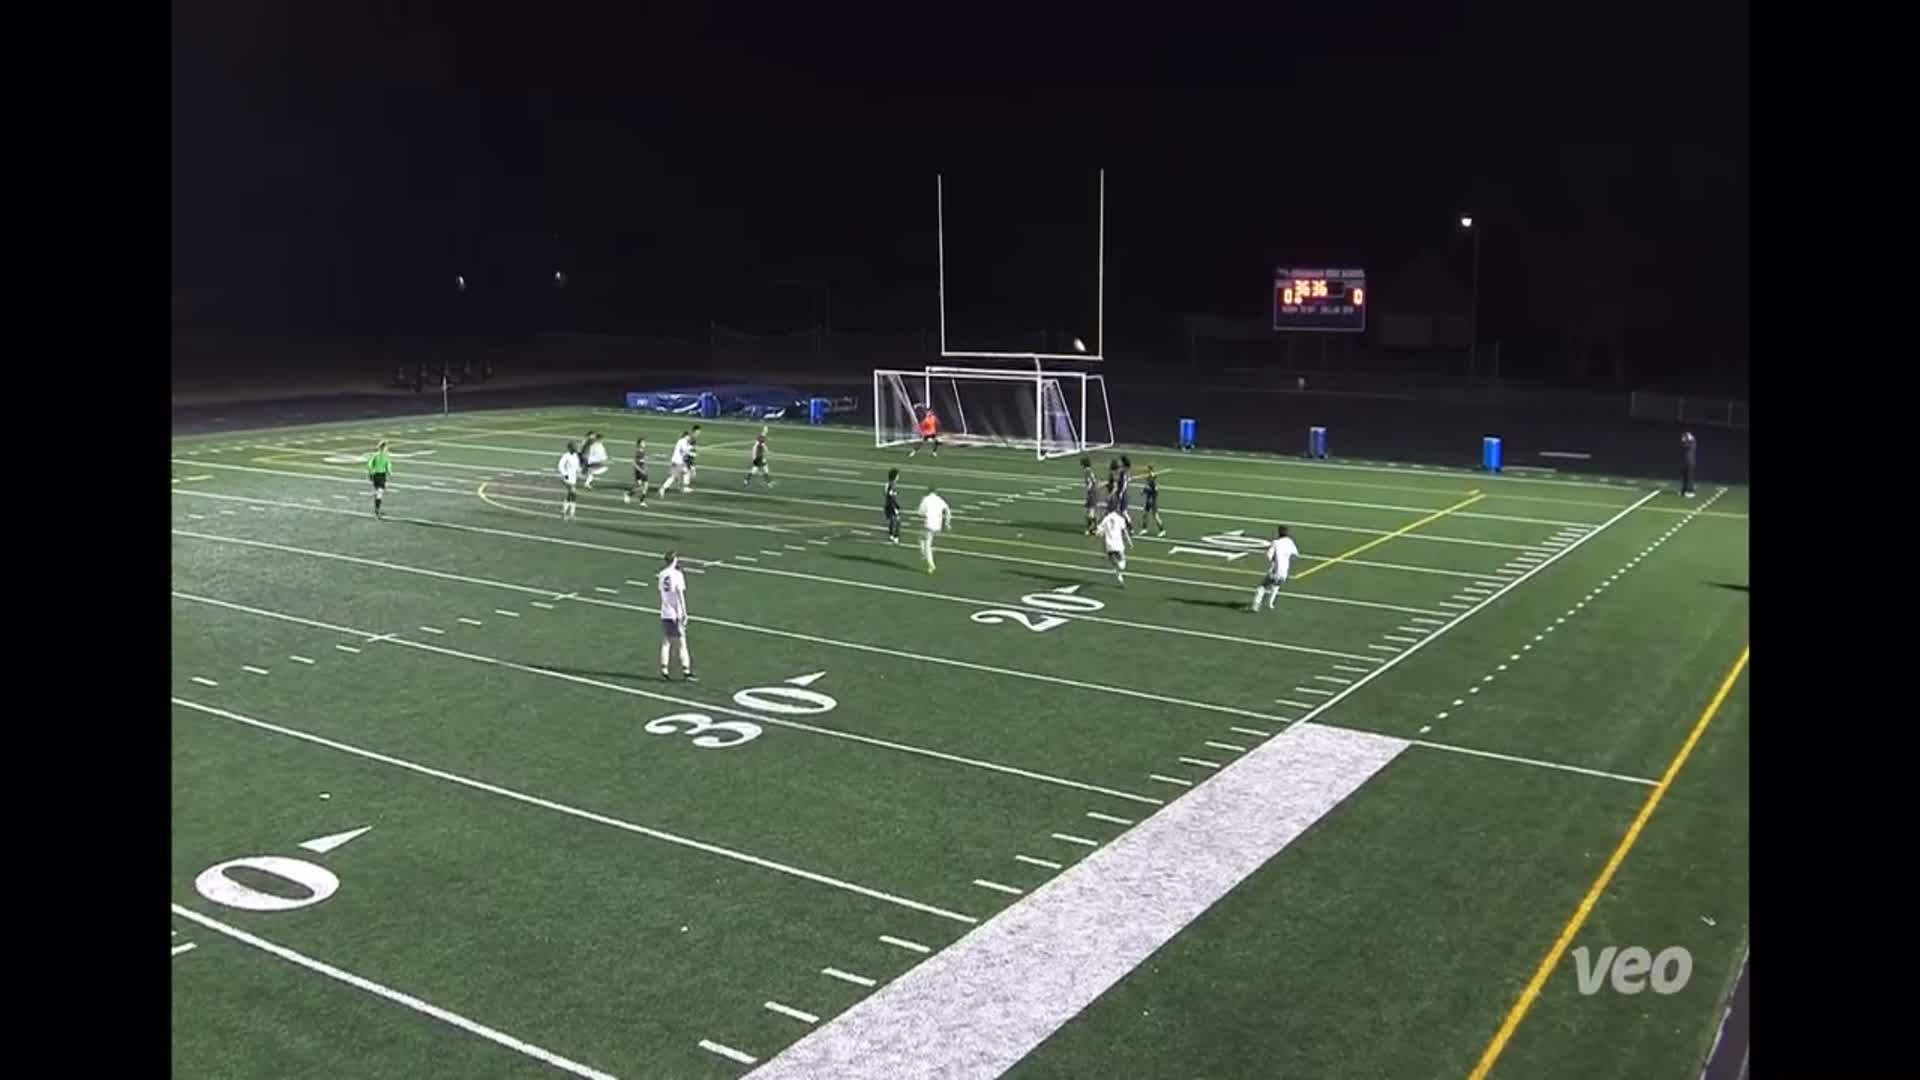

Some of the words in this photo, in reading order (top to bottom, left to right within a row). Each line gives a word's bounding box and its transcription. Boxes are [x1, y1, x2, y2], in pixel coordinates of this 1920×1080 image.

[1353, 288, 1363, 305] 0
[971, 592, 1105, 632] 20
[644, 686, 838, 748] 30
